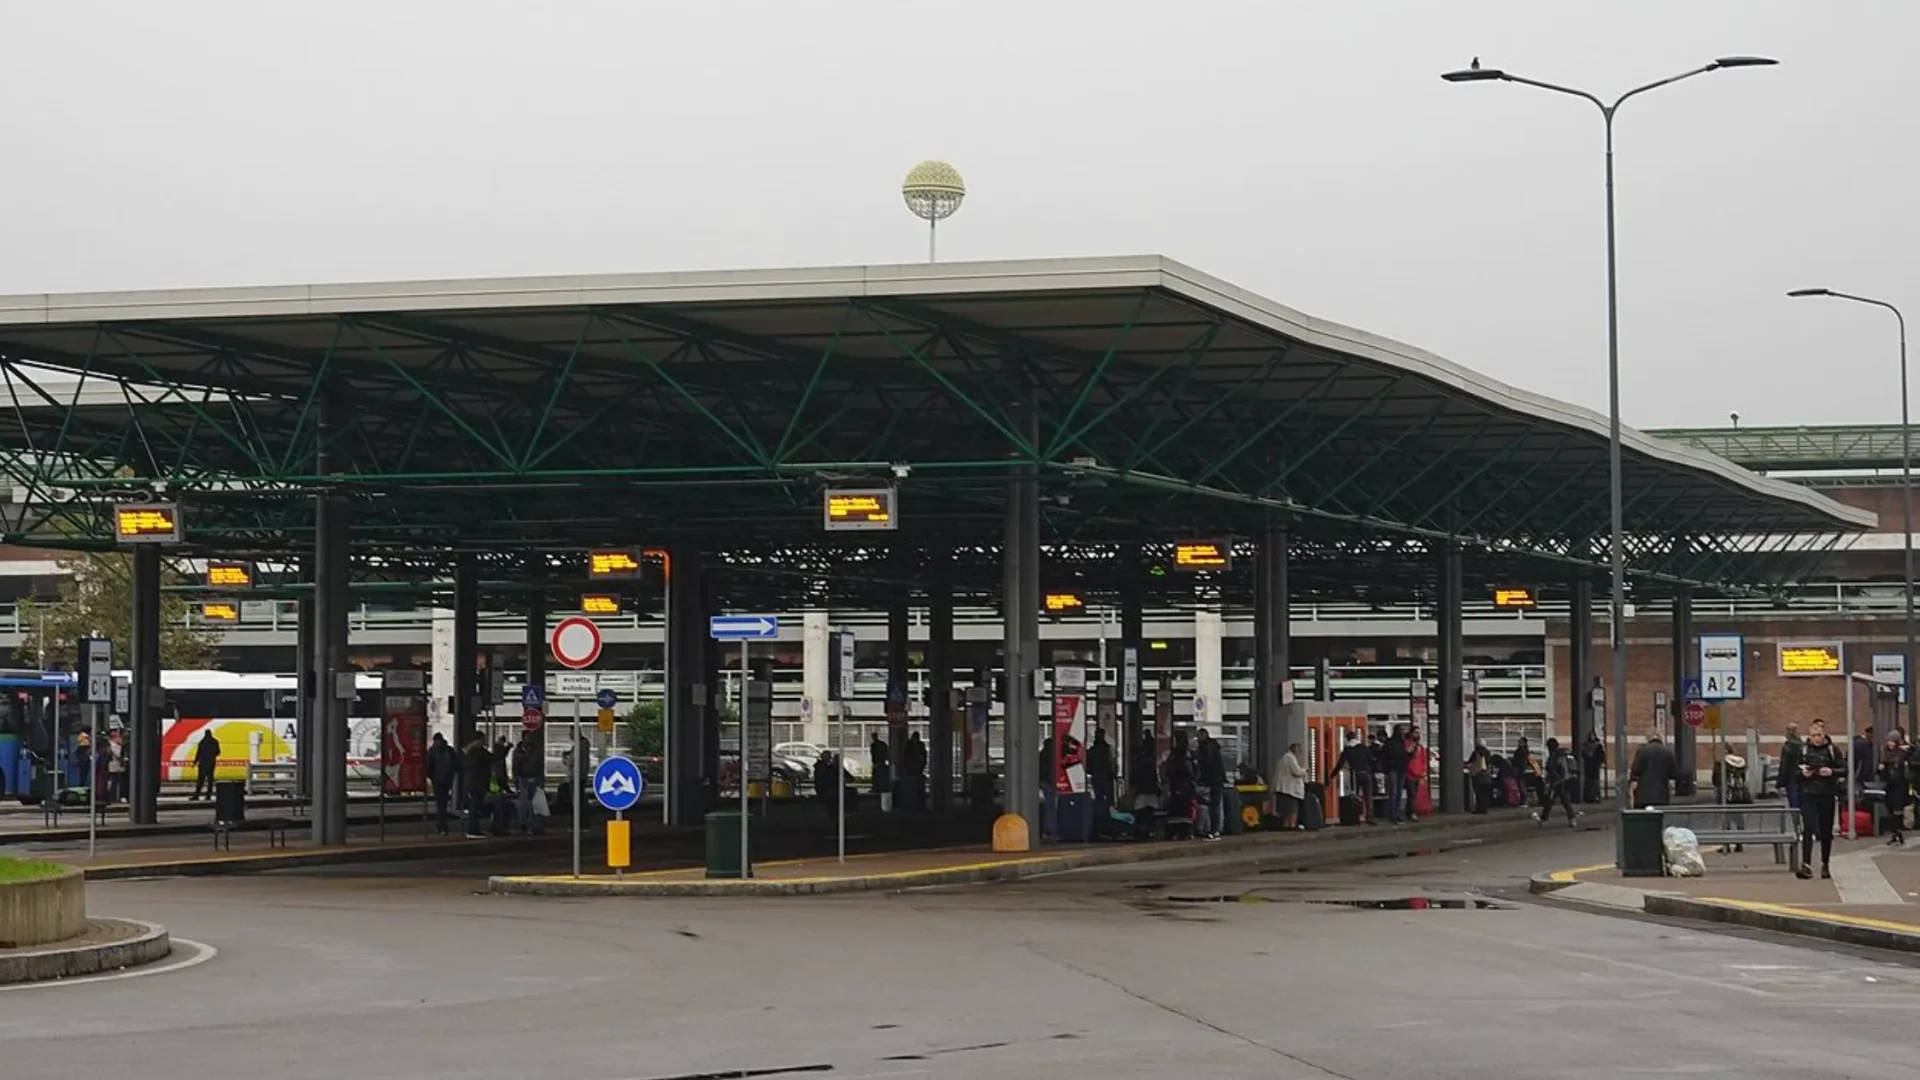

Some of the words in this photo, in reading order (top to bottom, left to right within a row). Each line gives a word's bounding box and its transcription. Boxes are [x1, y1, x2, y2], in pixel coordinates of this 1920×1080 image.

[91, 680, 98, 696] C
[102, 680, 108, 695] 1
[1707, 677, 1717, 692] A
[1727, 676, 1736, 691] 2
[1684, 711, 1704, 720] STOP
